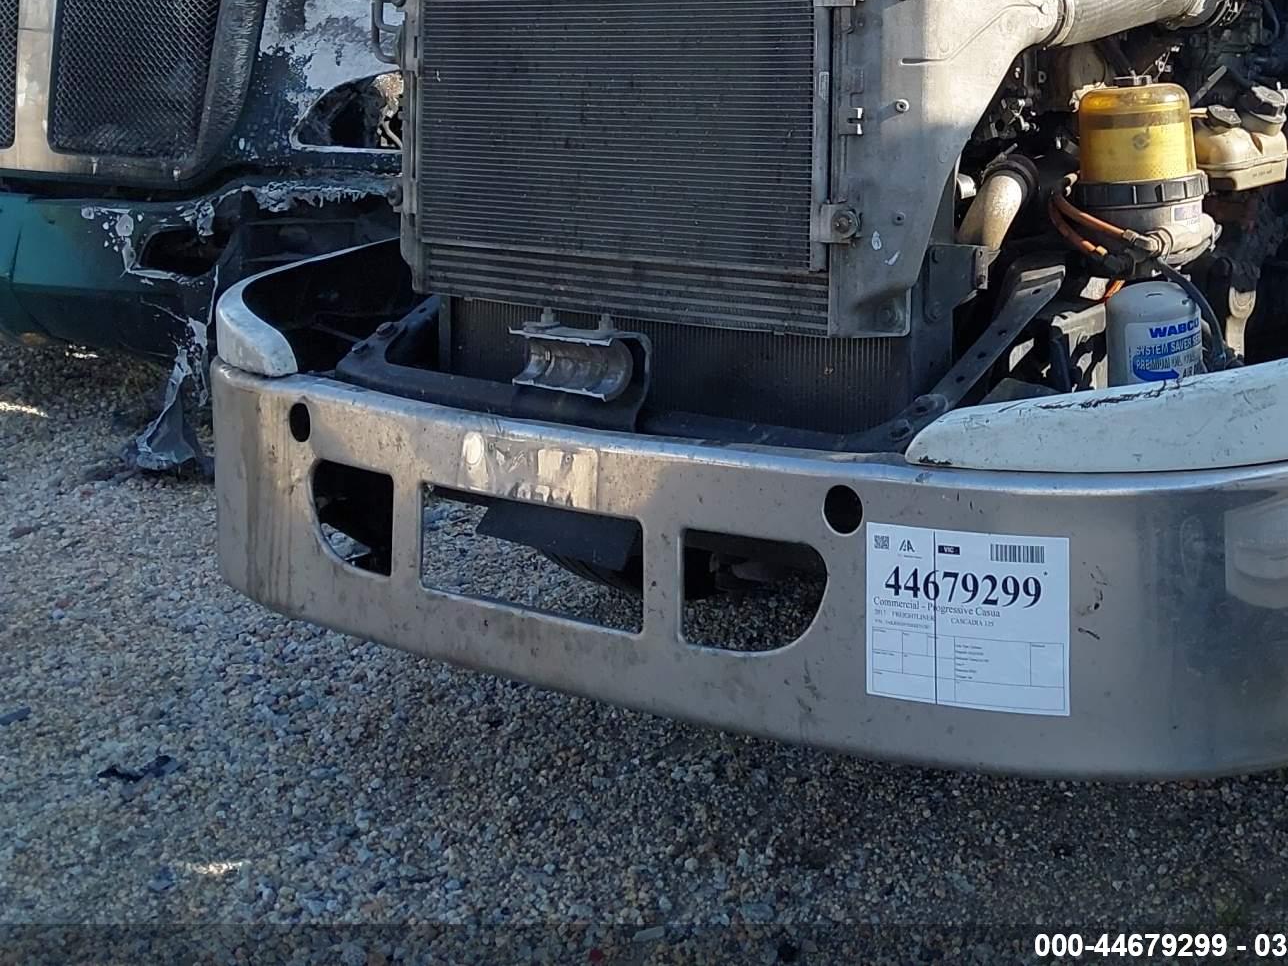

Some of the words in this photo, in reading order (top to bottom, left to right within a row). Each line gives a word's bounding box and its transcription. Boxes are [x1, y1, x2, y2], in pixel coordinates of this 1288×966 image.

[1149, 318, 1199, 338] WABCO
[1136, 343, 1169, 355] SYSTEM
[1170, 336, 1192, 354] SAVER
[1136, 356, 1170, 370] PREMIUM
[885, 565, 1042, 609] 44679299
[873, 595, 921, 611] Commercial
[927, 602, 974, 618] Progressive
